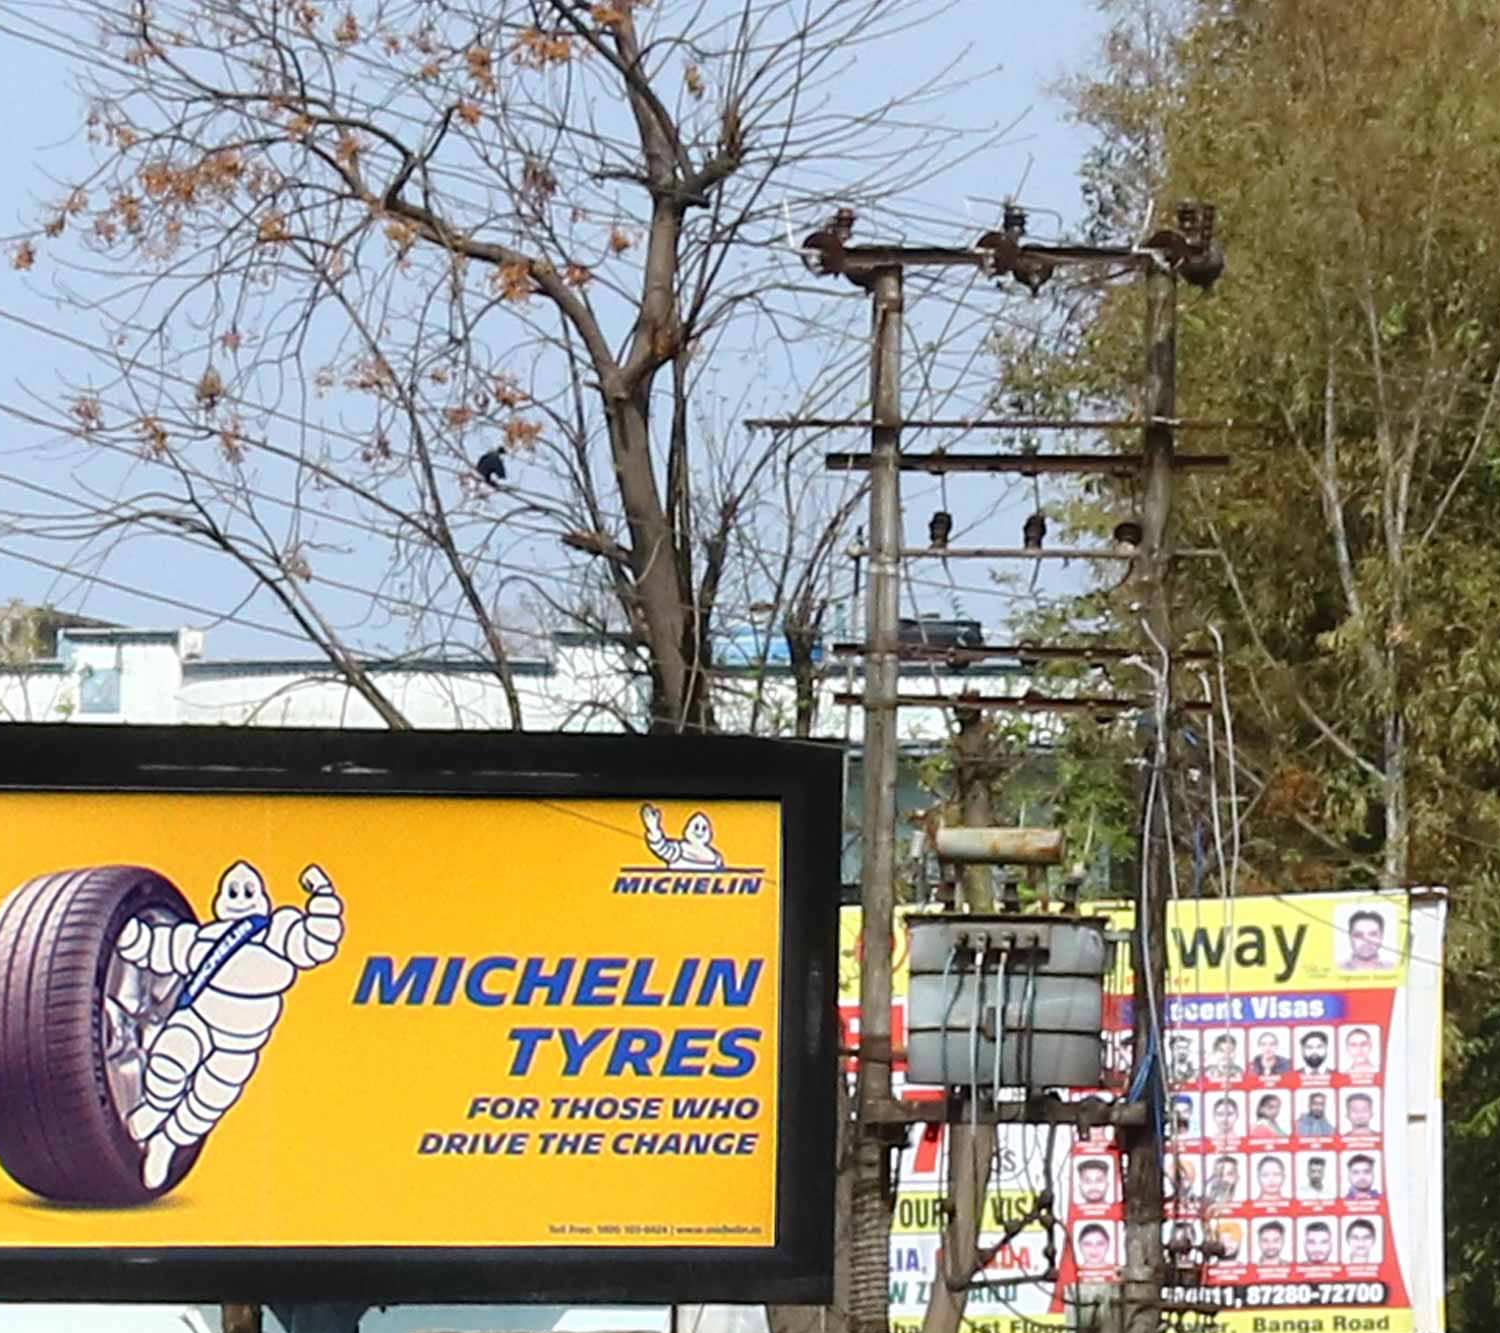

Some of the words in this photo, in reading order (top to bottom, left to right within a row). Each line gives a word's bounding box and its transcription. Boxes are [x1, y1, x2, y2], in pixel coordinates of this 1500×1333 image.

[613, 877, 763, 895] MICHELIN
[353, 957, 764, 1007] MICHELIN
[1251, 995, 1325, 1020] Visas
[509, 1028, 763, 1077] TYRES
[467, 1096, 540, 1120] FOR
[550, 1097, 664, 1120] THOSE
[672, 1097, 760, 1120] WHO
[417, 1132, 530, 1156] DRIVE
[538, 1133, 604, 1156] THE
[612, 1133, 759, 1156] CHANGE
[1246, 1283, 1384, 1305] 87280-72700
[1332, 1315, 1390, 1332] Road
